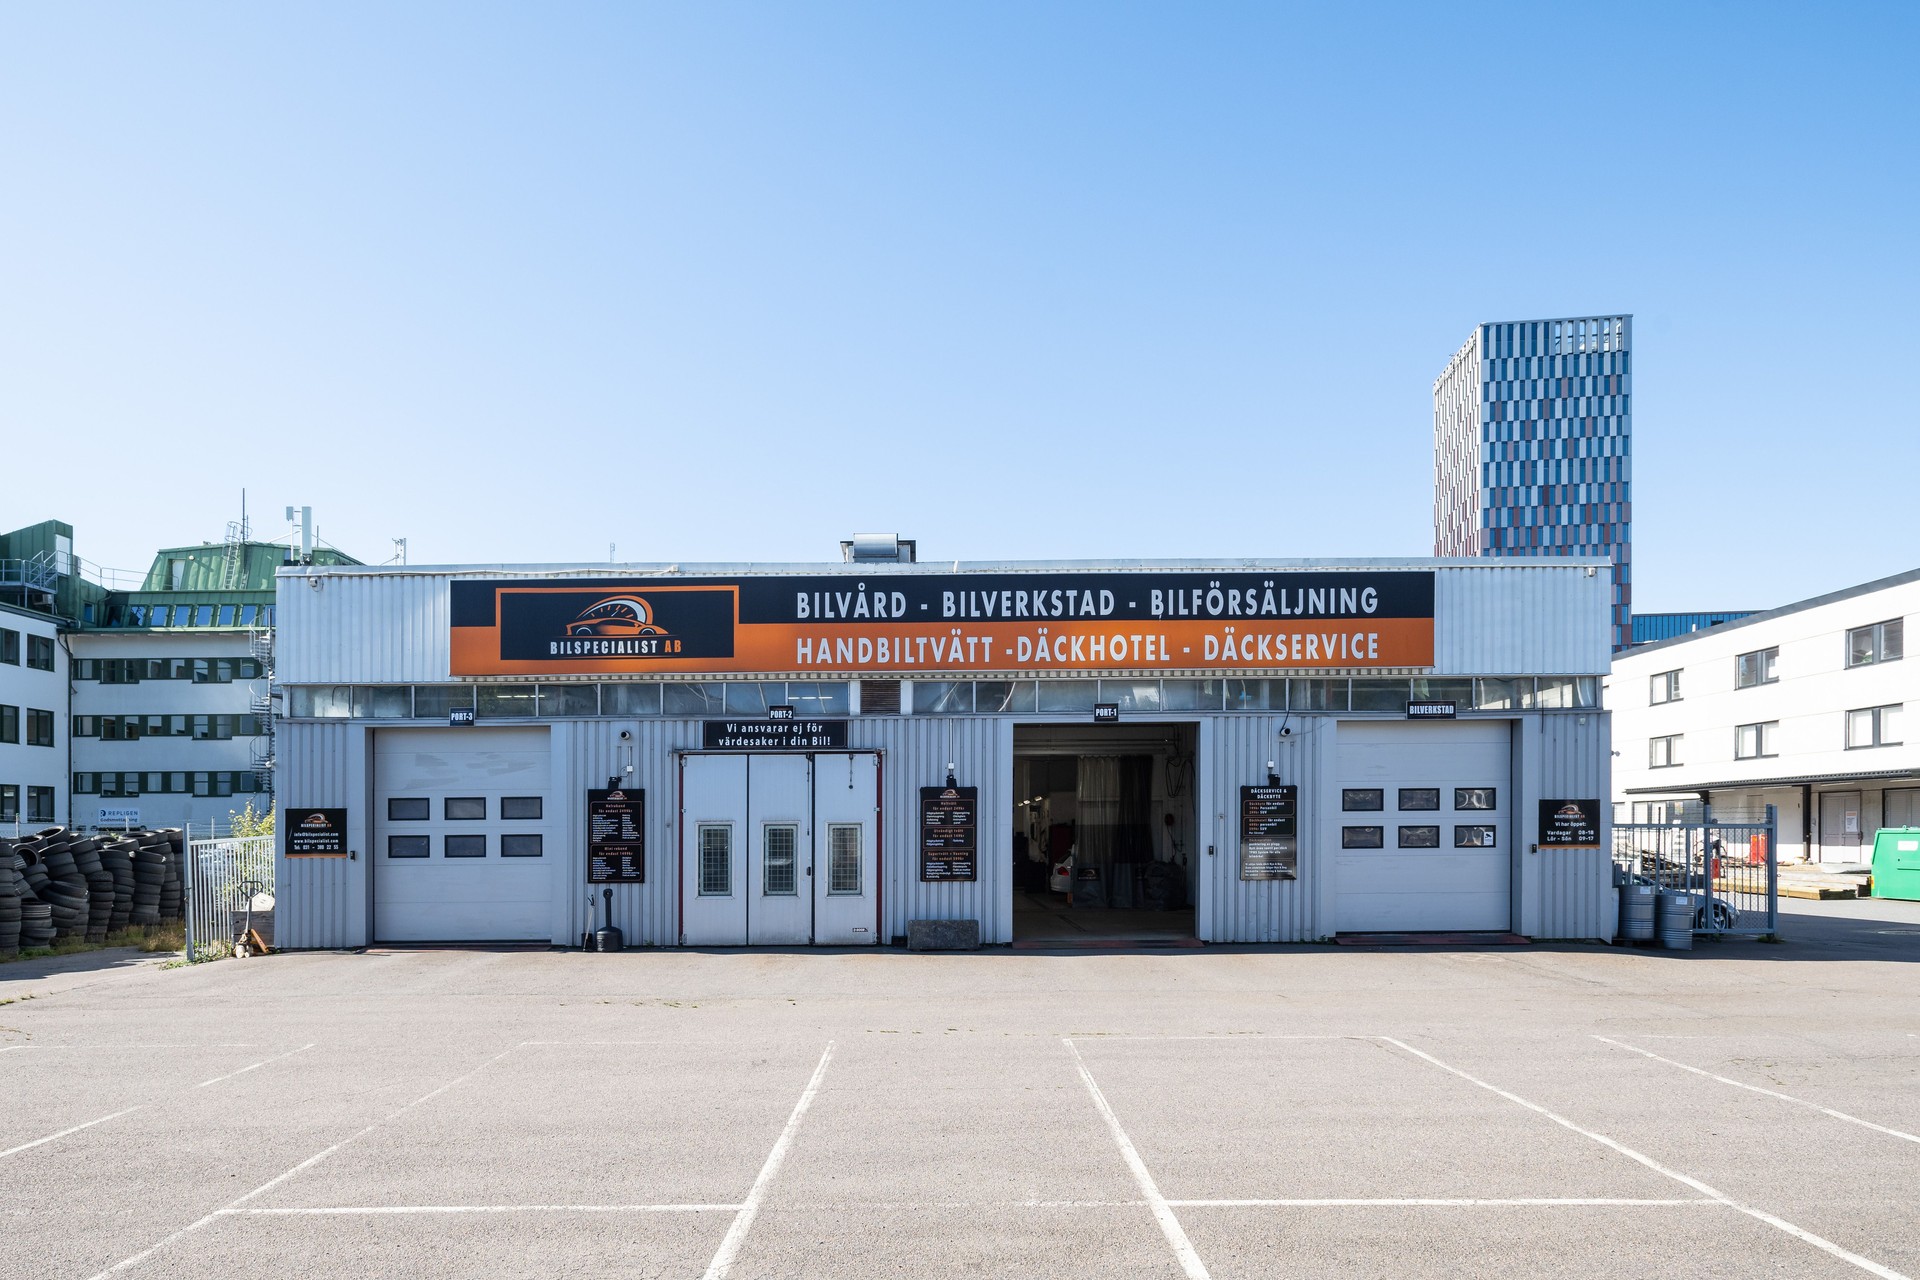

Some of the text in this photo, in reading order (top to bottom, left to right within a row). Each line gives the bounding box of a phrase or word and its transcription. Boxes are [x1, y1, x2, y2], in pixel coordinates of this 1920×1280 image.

[796, 582, 906, 619] BILVÅRD
[943, 589, 1115, 617] BILVERKSTAD
[1151, 581, 1378, 616] BILFÖRSÄLJNING
[550, 640, 682, 655] BILSPECIALIST AB
[797, 628, 993, 664] HANDBILTVÄTT
[1204, 627, 1378, 661] DÄCKSERVICE
[770, 709, 793, 719] PORT-2
[1095, 708, 1117, 717] PORT-1
[1409, 705, 1455, 715] BILVERKSTAD
[451, 711, 473, 721] PORT-3
[726, 722, 823, 735] Vi ansvarar ej för
[719, 736, 778, 746] värdesaker
[791, 736, 809, 746] din
[812, 735, 831, 746] Bil!
